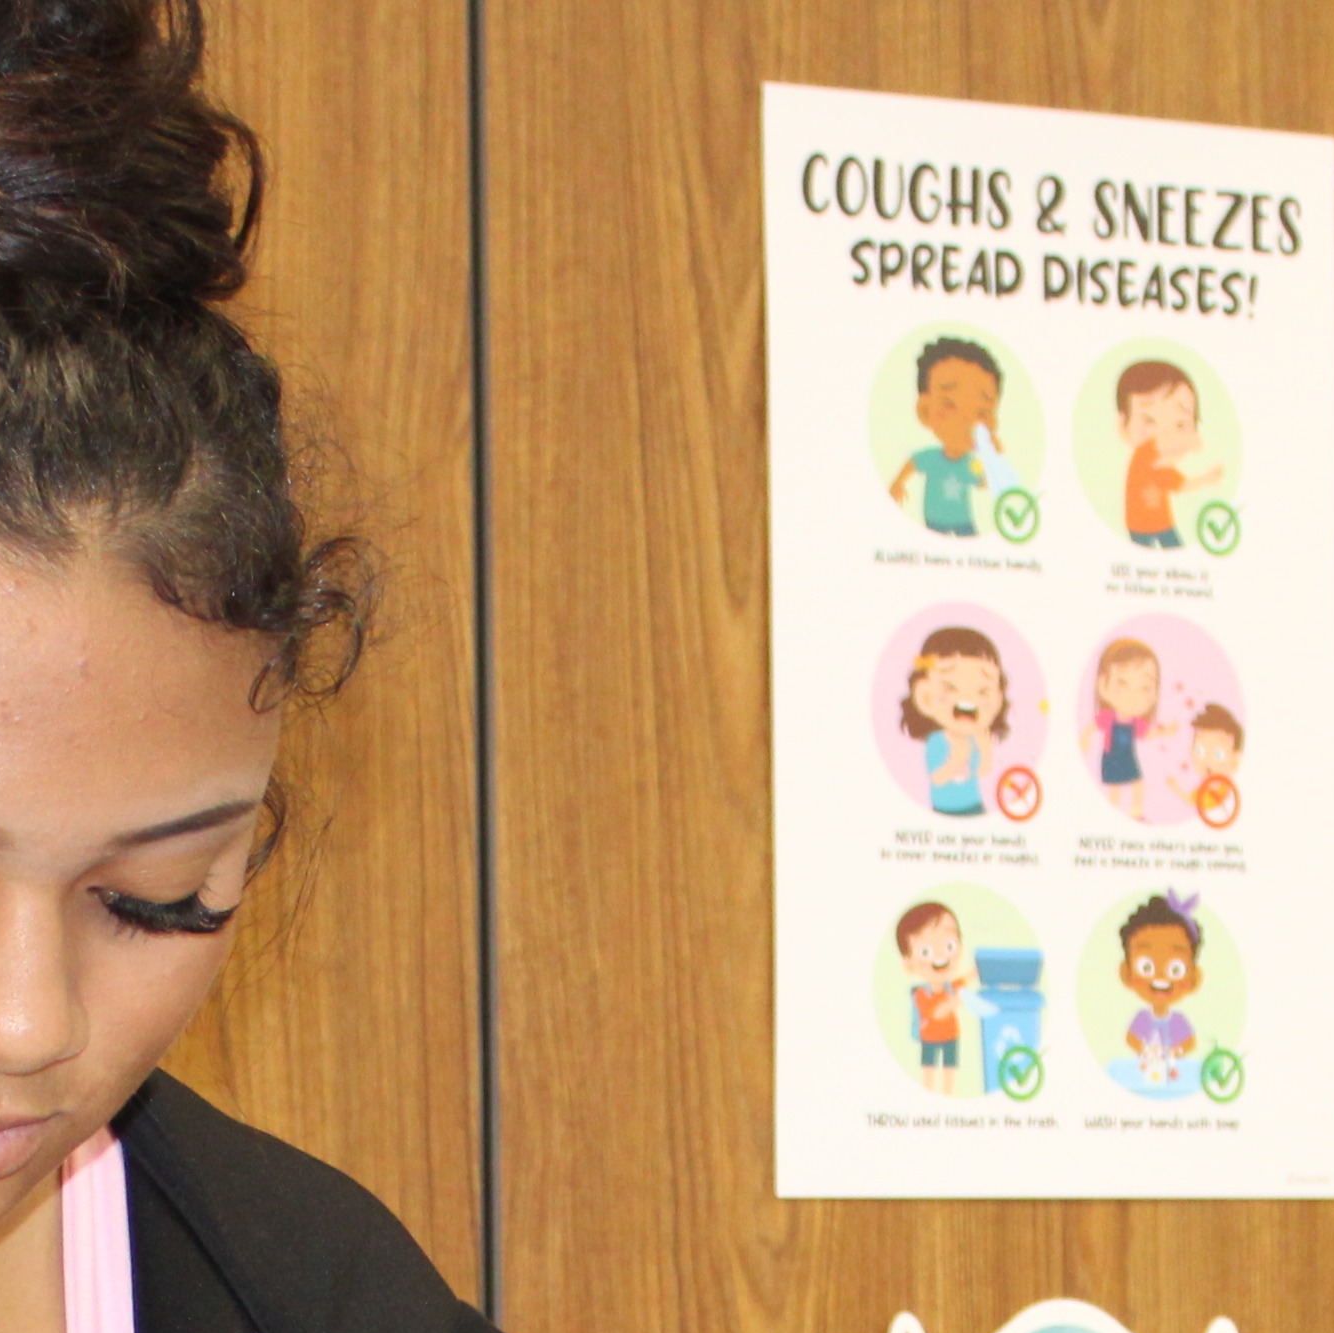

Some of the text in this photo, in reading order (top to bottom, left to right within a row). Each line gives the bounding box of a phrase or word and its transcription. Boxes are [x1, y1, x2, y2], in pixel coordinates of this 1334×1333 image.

[800, 151, 1303, 256] COUGHS & SNEEZES
[849, 239, 1258, 319] SPREAD DISEASES!
